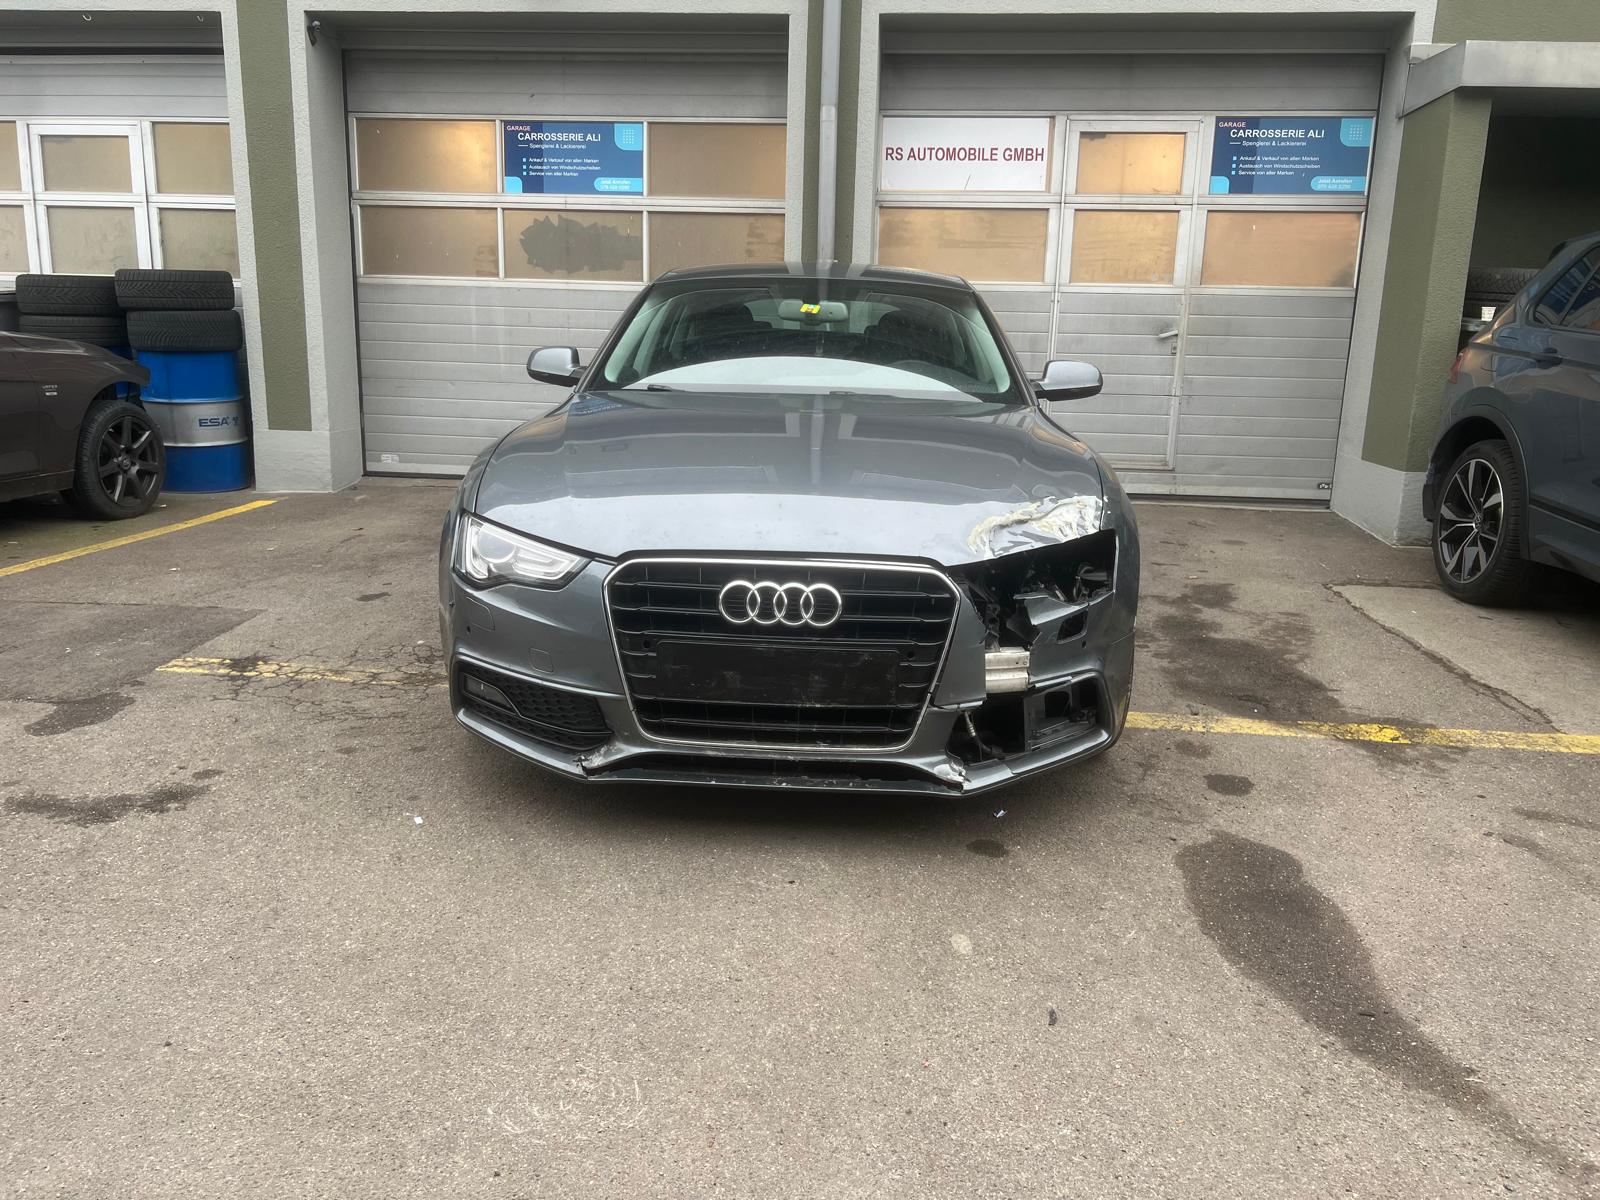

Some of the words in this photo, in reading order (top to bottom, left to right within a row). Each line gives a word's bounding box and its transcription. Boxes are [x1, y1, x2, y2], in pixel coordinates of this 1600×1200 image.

[518, 132, 584, 141] CARROSSERIE
[585, 133, 601, 142] ALI
[1230, 129, 1305, 138] CARROSSERIE
[1307, 129, 1325, 138] ALI
[885, 147, 904, 161] RS
[907, 147, 998, 161] AUTOMOBILE
[1002, 147, 1045, 162] GMBH
[198, 416, 229, 428] ESA
